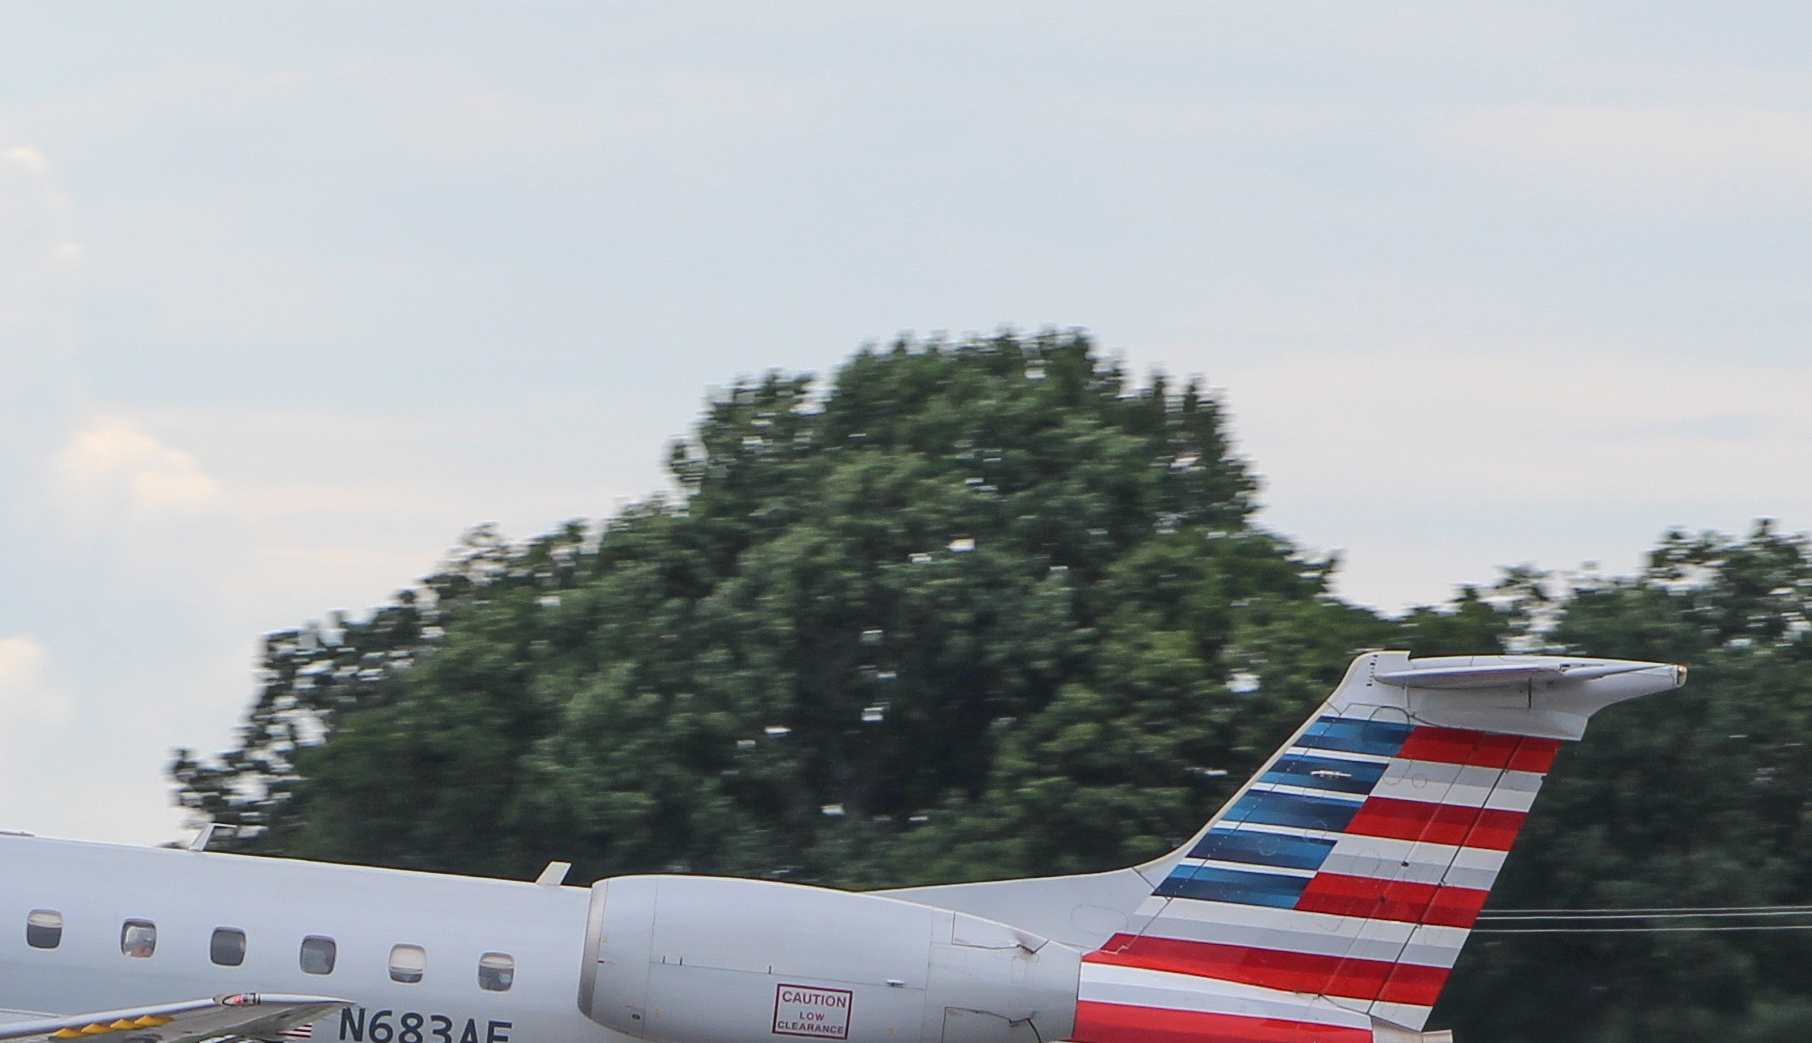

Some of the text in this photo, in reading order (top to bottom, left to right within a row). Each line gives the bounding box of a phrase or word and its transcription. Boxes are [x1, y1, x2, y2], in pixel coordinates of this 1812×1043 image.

[782, 991, 847, 1008] CAUTION
[799, 1011, 825, 1021] LOW
[777, 1020, 844, 1035] CLEARANCE
